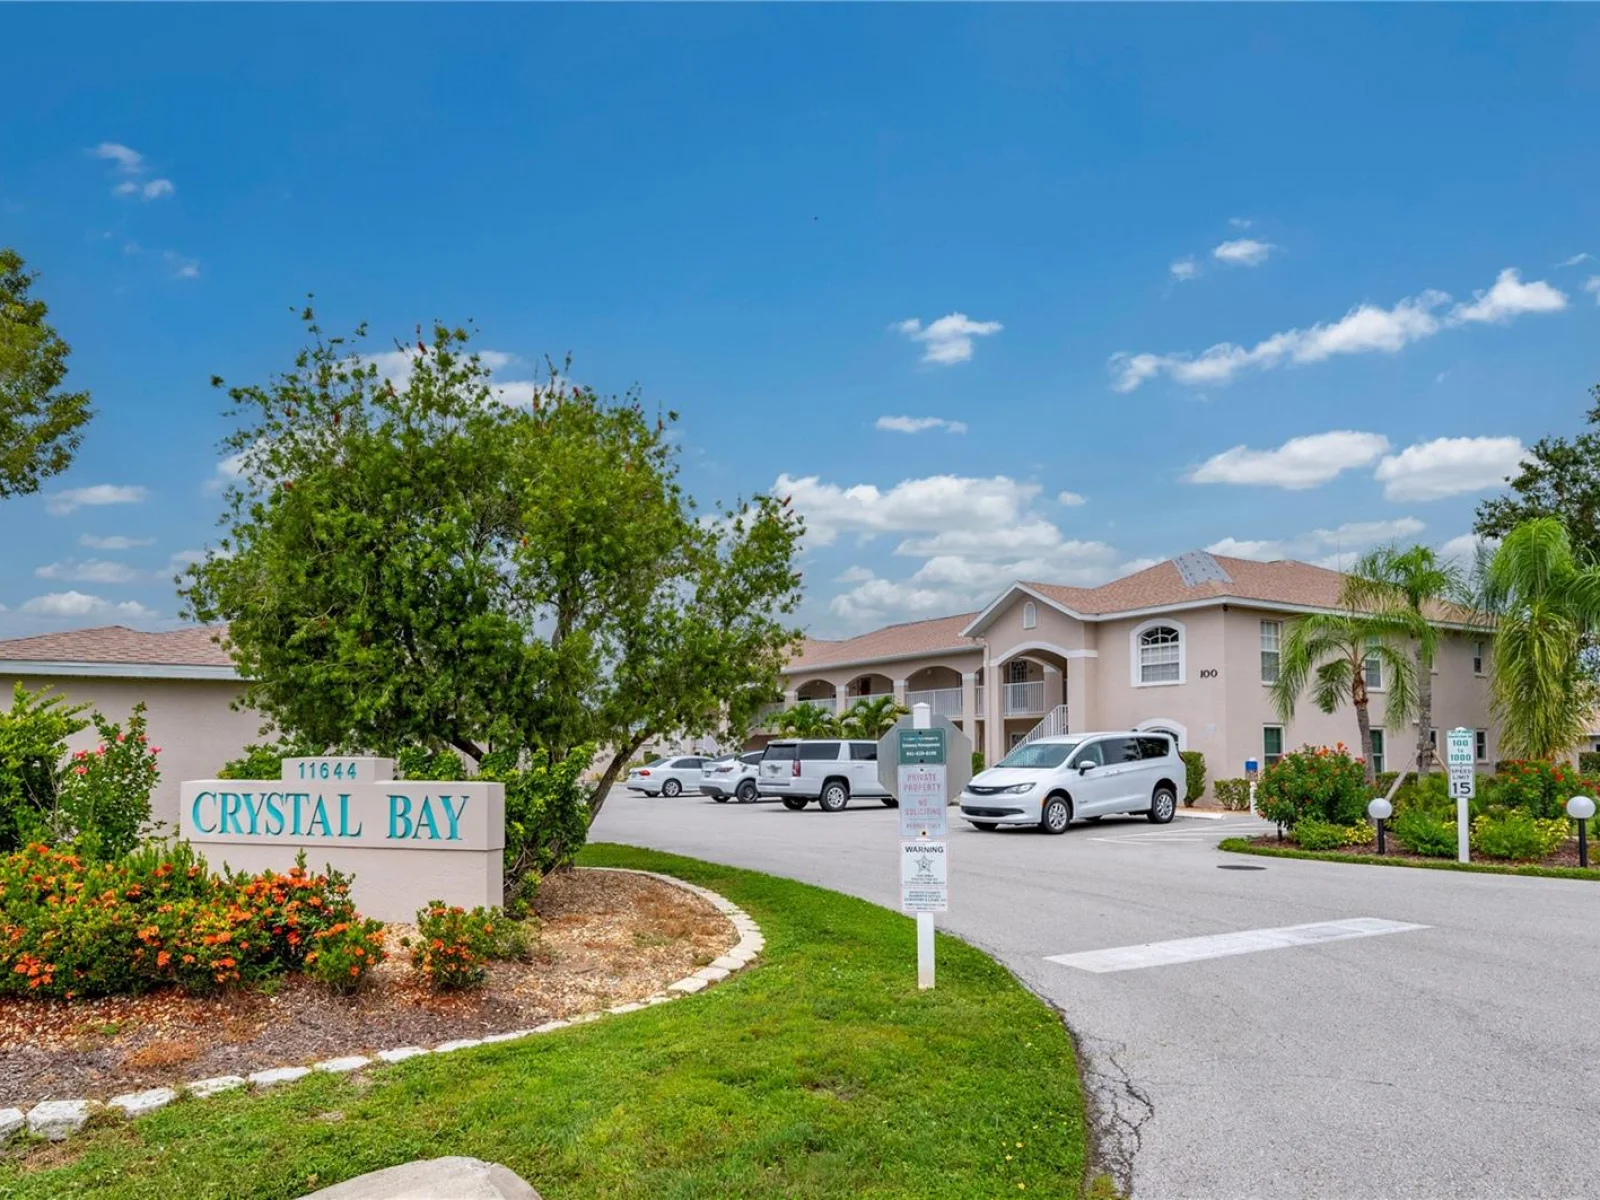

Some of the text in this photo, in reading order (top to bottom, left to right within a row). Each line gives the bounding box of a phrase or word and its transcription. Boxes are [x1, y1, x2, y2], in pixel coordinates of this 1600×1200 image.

[1200, 669, 1218, 678] 100
[298, 762, 358, 780] 11644
[907, 773, 937, 781] PRIVATE
[904, 784, 941, 792] PROPERTY
[1452, 782, 1471, 794] 15
[191, 791, 471, 841] CRYSTAL BAY
